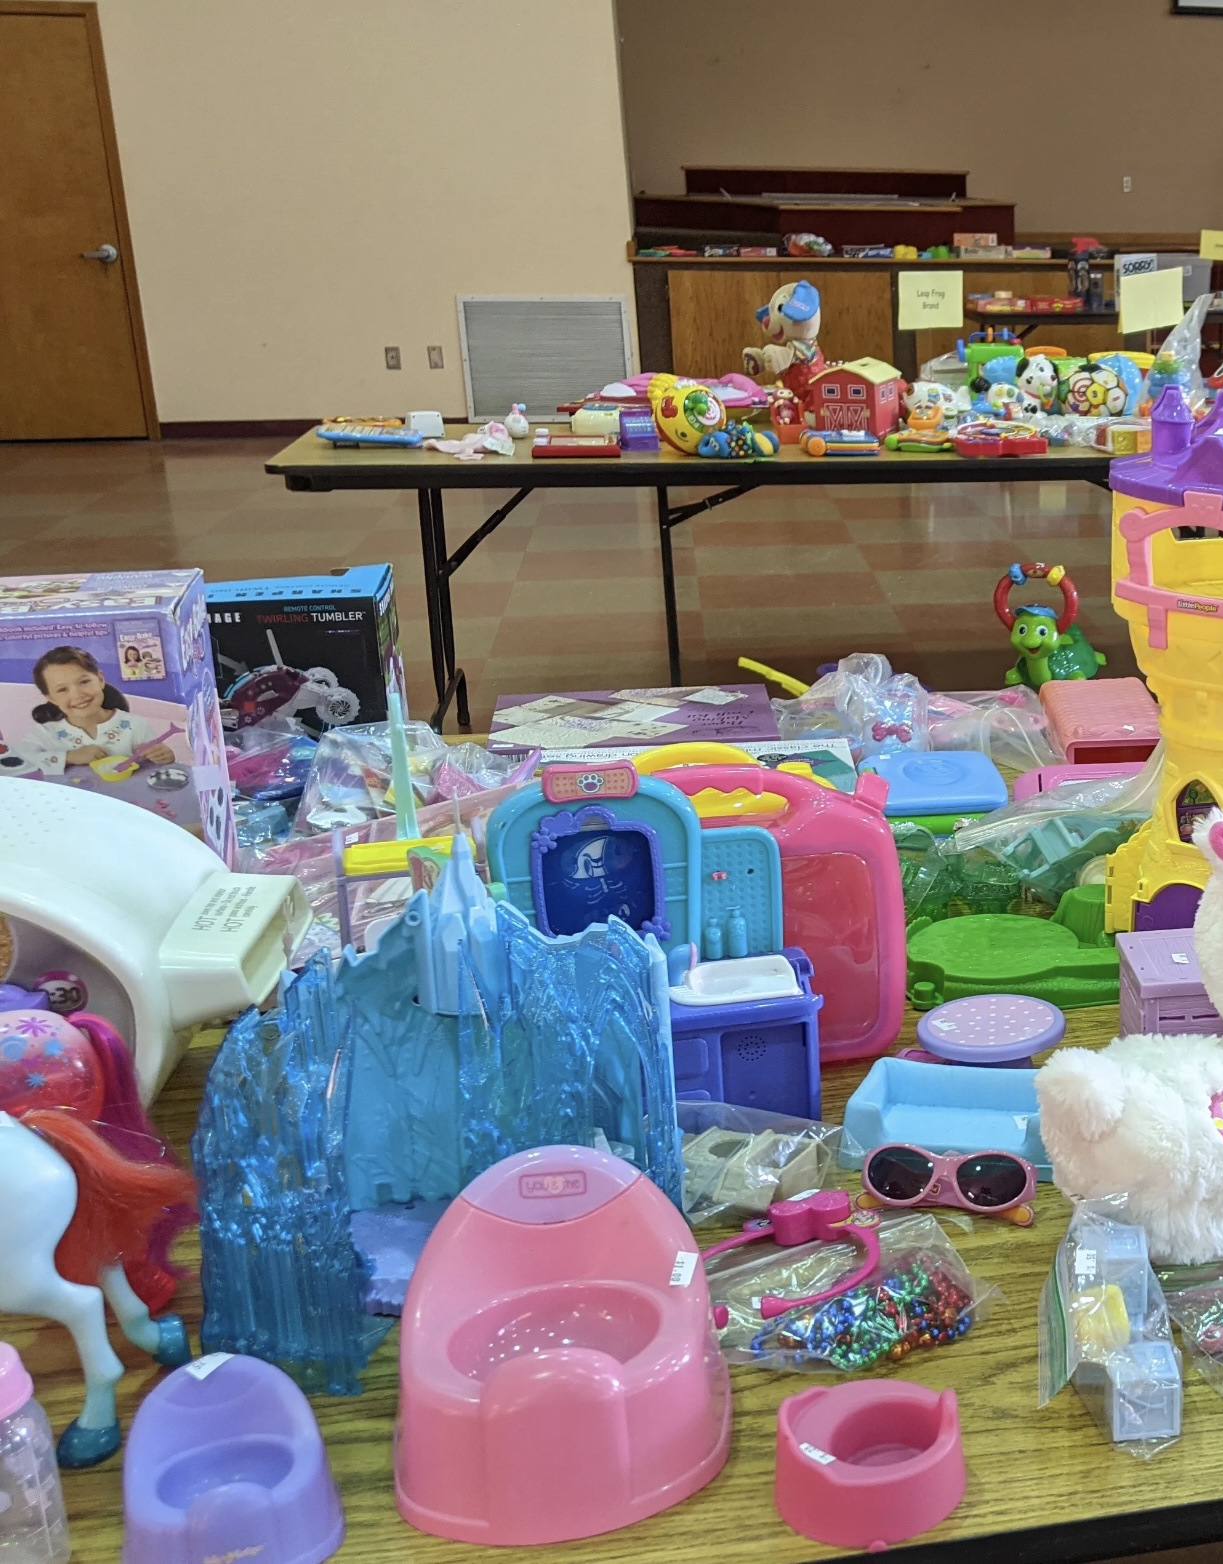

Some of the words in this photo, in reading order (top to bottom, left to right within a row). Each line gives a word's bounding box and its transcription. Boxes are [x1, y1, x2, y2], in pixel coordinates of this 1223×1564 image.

[916, 289, 930, 299] Leap
[931, 289, 945, 299] Frog
[922, 301, 940, 310] Brand
[256, 613, 309, 624] TWIRLING
[312, 611, 366, 622] TUMBLER
[192, 916, 217, 931] HOT
[220, 918, 246, 932] HOT
[671, 1260, 685, 1282] $1.00
